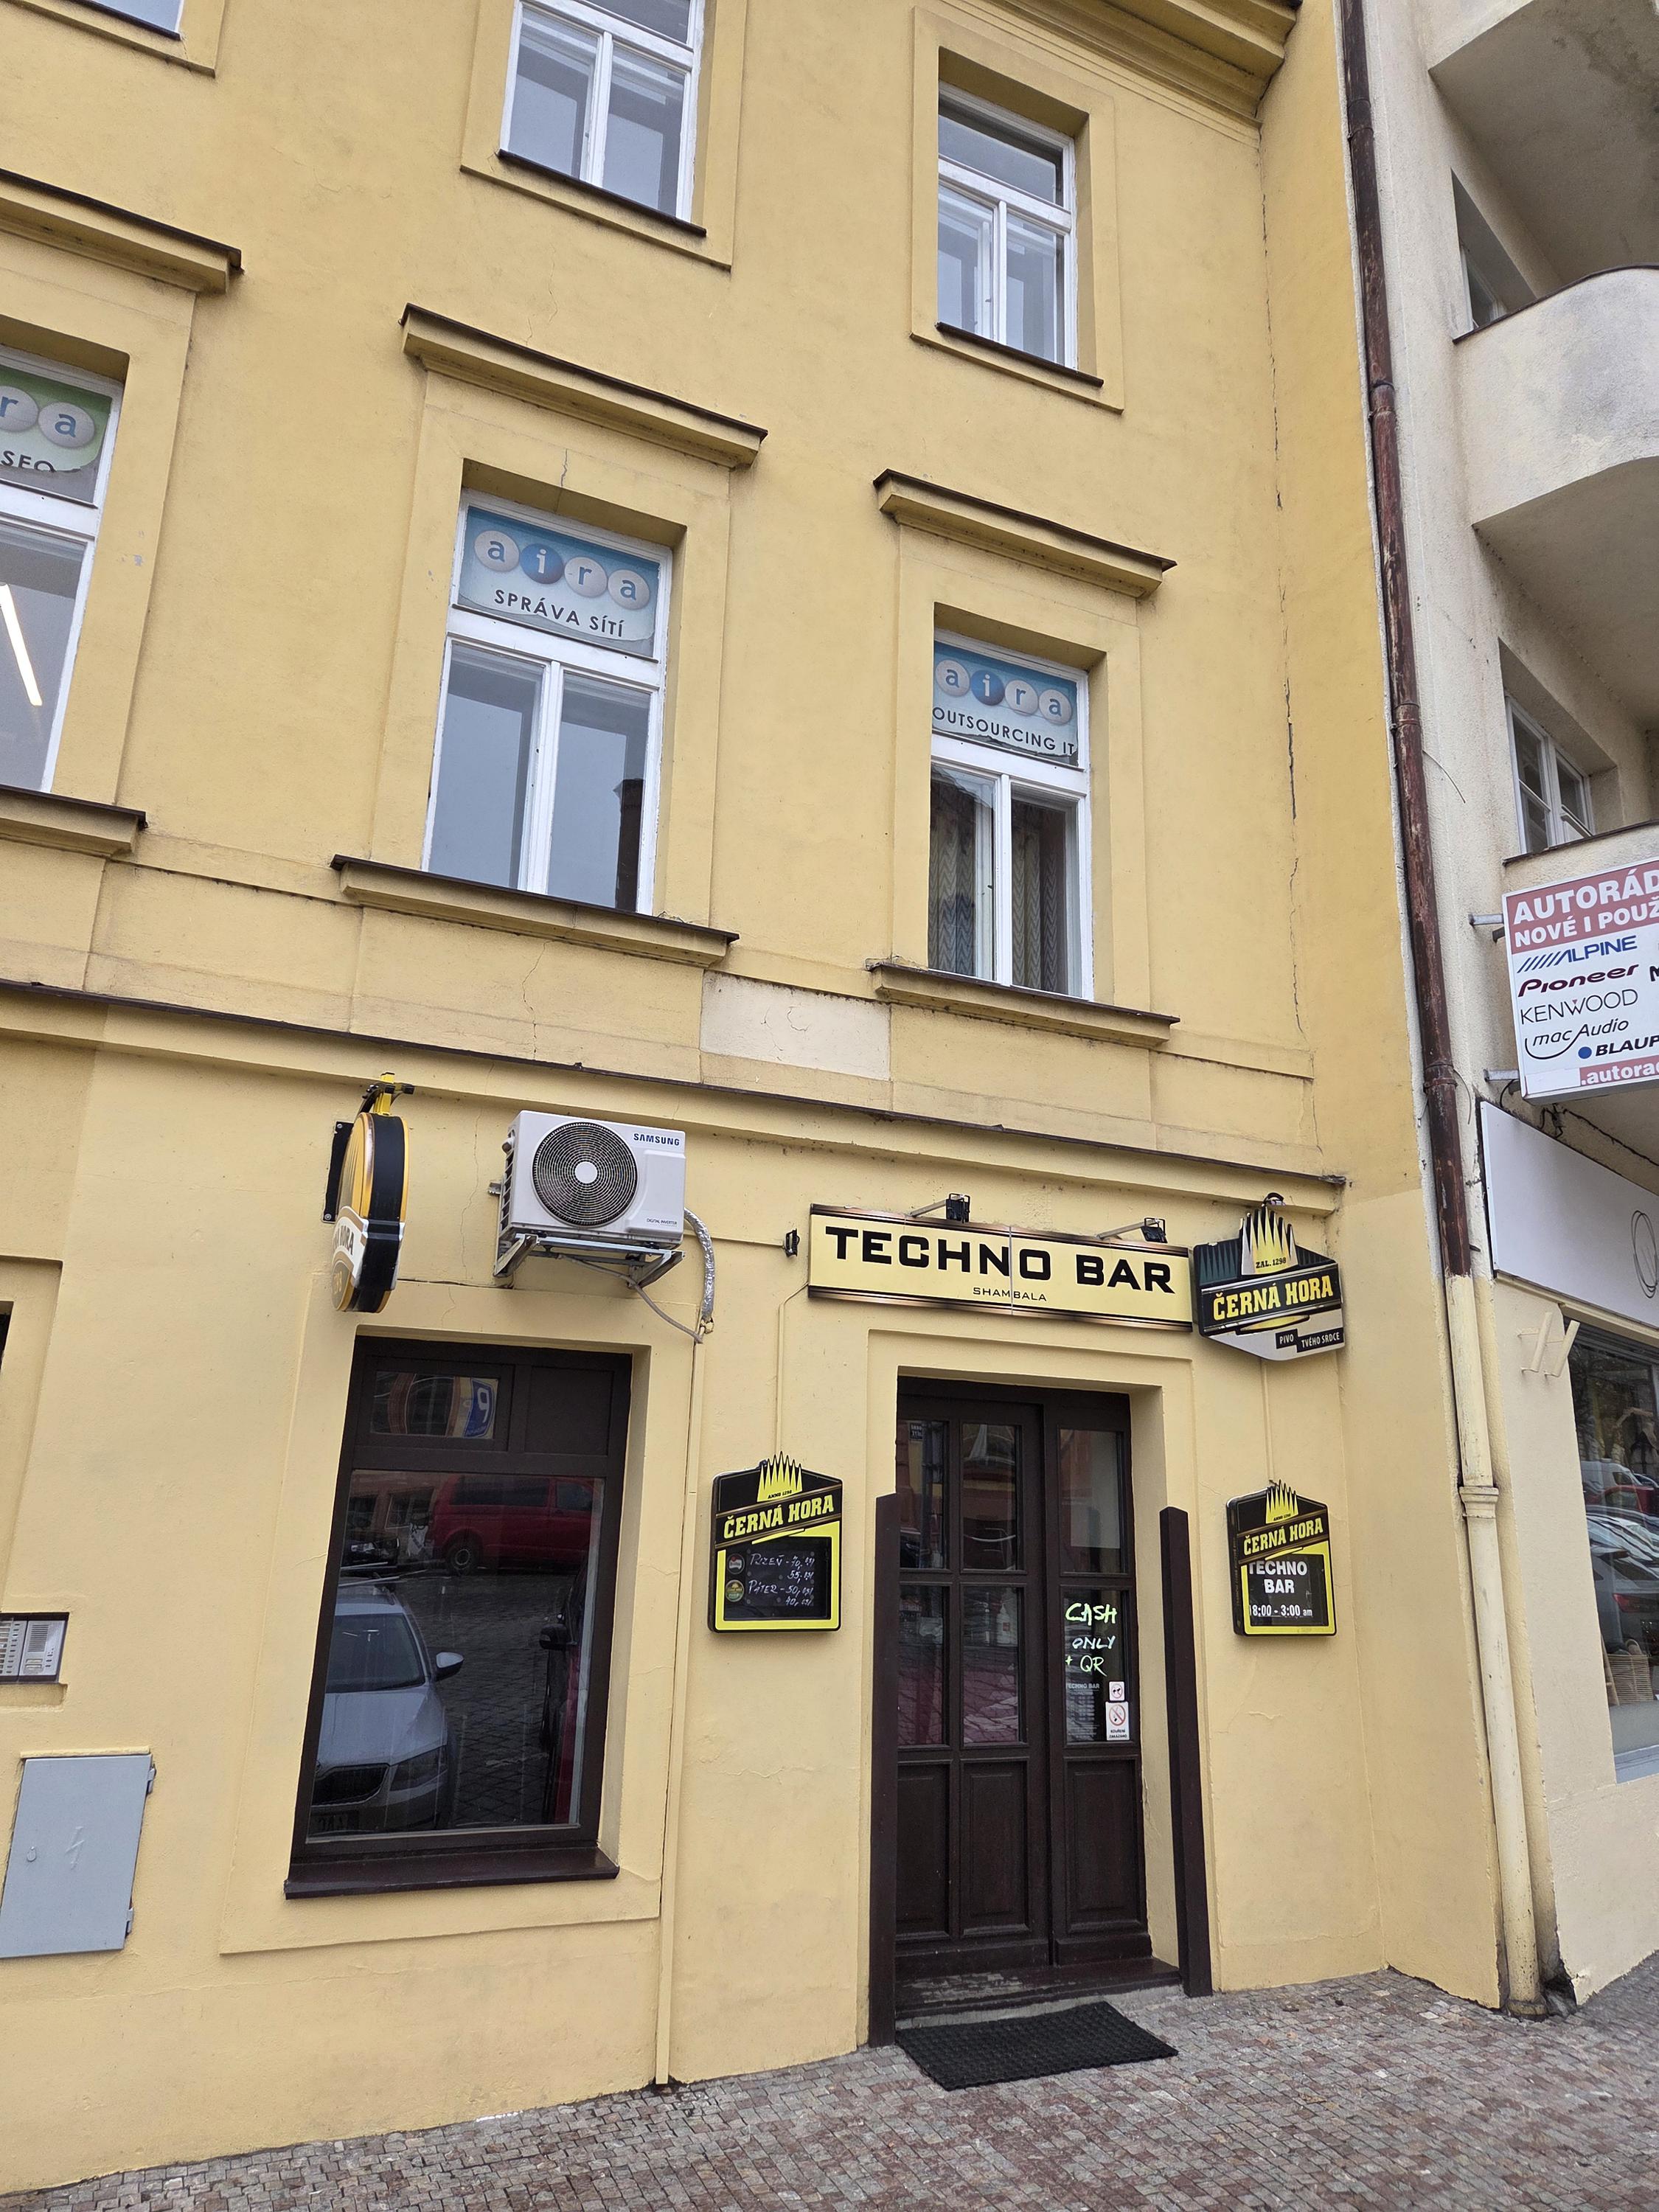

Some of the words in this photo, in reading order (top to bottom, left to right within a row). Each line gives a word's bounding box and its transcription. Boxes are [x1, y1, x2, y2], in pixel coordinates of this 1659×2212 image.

[487, 540, 636, 601] aira
[494, 589, 580, 626] SPRÁVA
[589, 615, 625, 637] SÍTÍ
[945, 669, 1062, 717] aira
[932, 706, 1056, 751] OUTSOURCING
[1062, 742, 1074, 754] IT
[1514, 916, 1578, 948] NOVÉ
[1584, 916, 1592, 933] I
[1517, 964, 1639, 998] Pioneer
[1520, 988, 1638, 1025] KENWOOD
[1532, 1029, 1573, 1047] mac
[1569, 1018, 1630, 1039] Audio
[633, 1133, 680, 1146] SAMSUNG
[825, 1225, 1051, 1281] TECHNO
[1076, 1253, 1175, 1294] BAR
[973, 1287, 1047, 1302] SHAMBALA
[1212, 1283, 1281, 1321] ČERNÁ
[1285, 1275, 1334, 1306] HORA
[1279, 1334, 1295, 1346] PIVO
[1301, 1335, 1321, 1349] TVÉHO
[1321, 1332, 1340, 1343] SRDCE
[723, 1504, 784, 1540] ČERNÁ
[787, 1494, 835, 1523] HORA
[1243, 1526, 1287, 1556] ČERNÁ
[1289, 1517, 1324, 1543] HORA
[1263, 1578, 1295, 1594] BAR
[1065, 1602, 1118, 1627] CASH
[1280, 1604, 1301, 1617] 3:00
[1302, 1608, 1312, 1616] am
[1071, 1635, 1116, 1650] ONLY
[1079, 1655, 1108, 1677] QR
